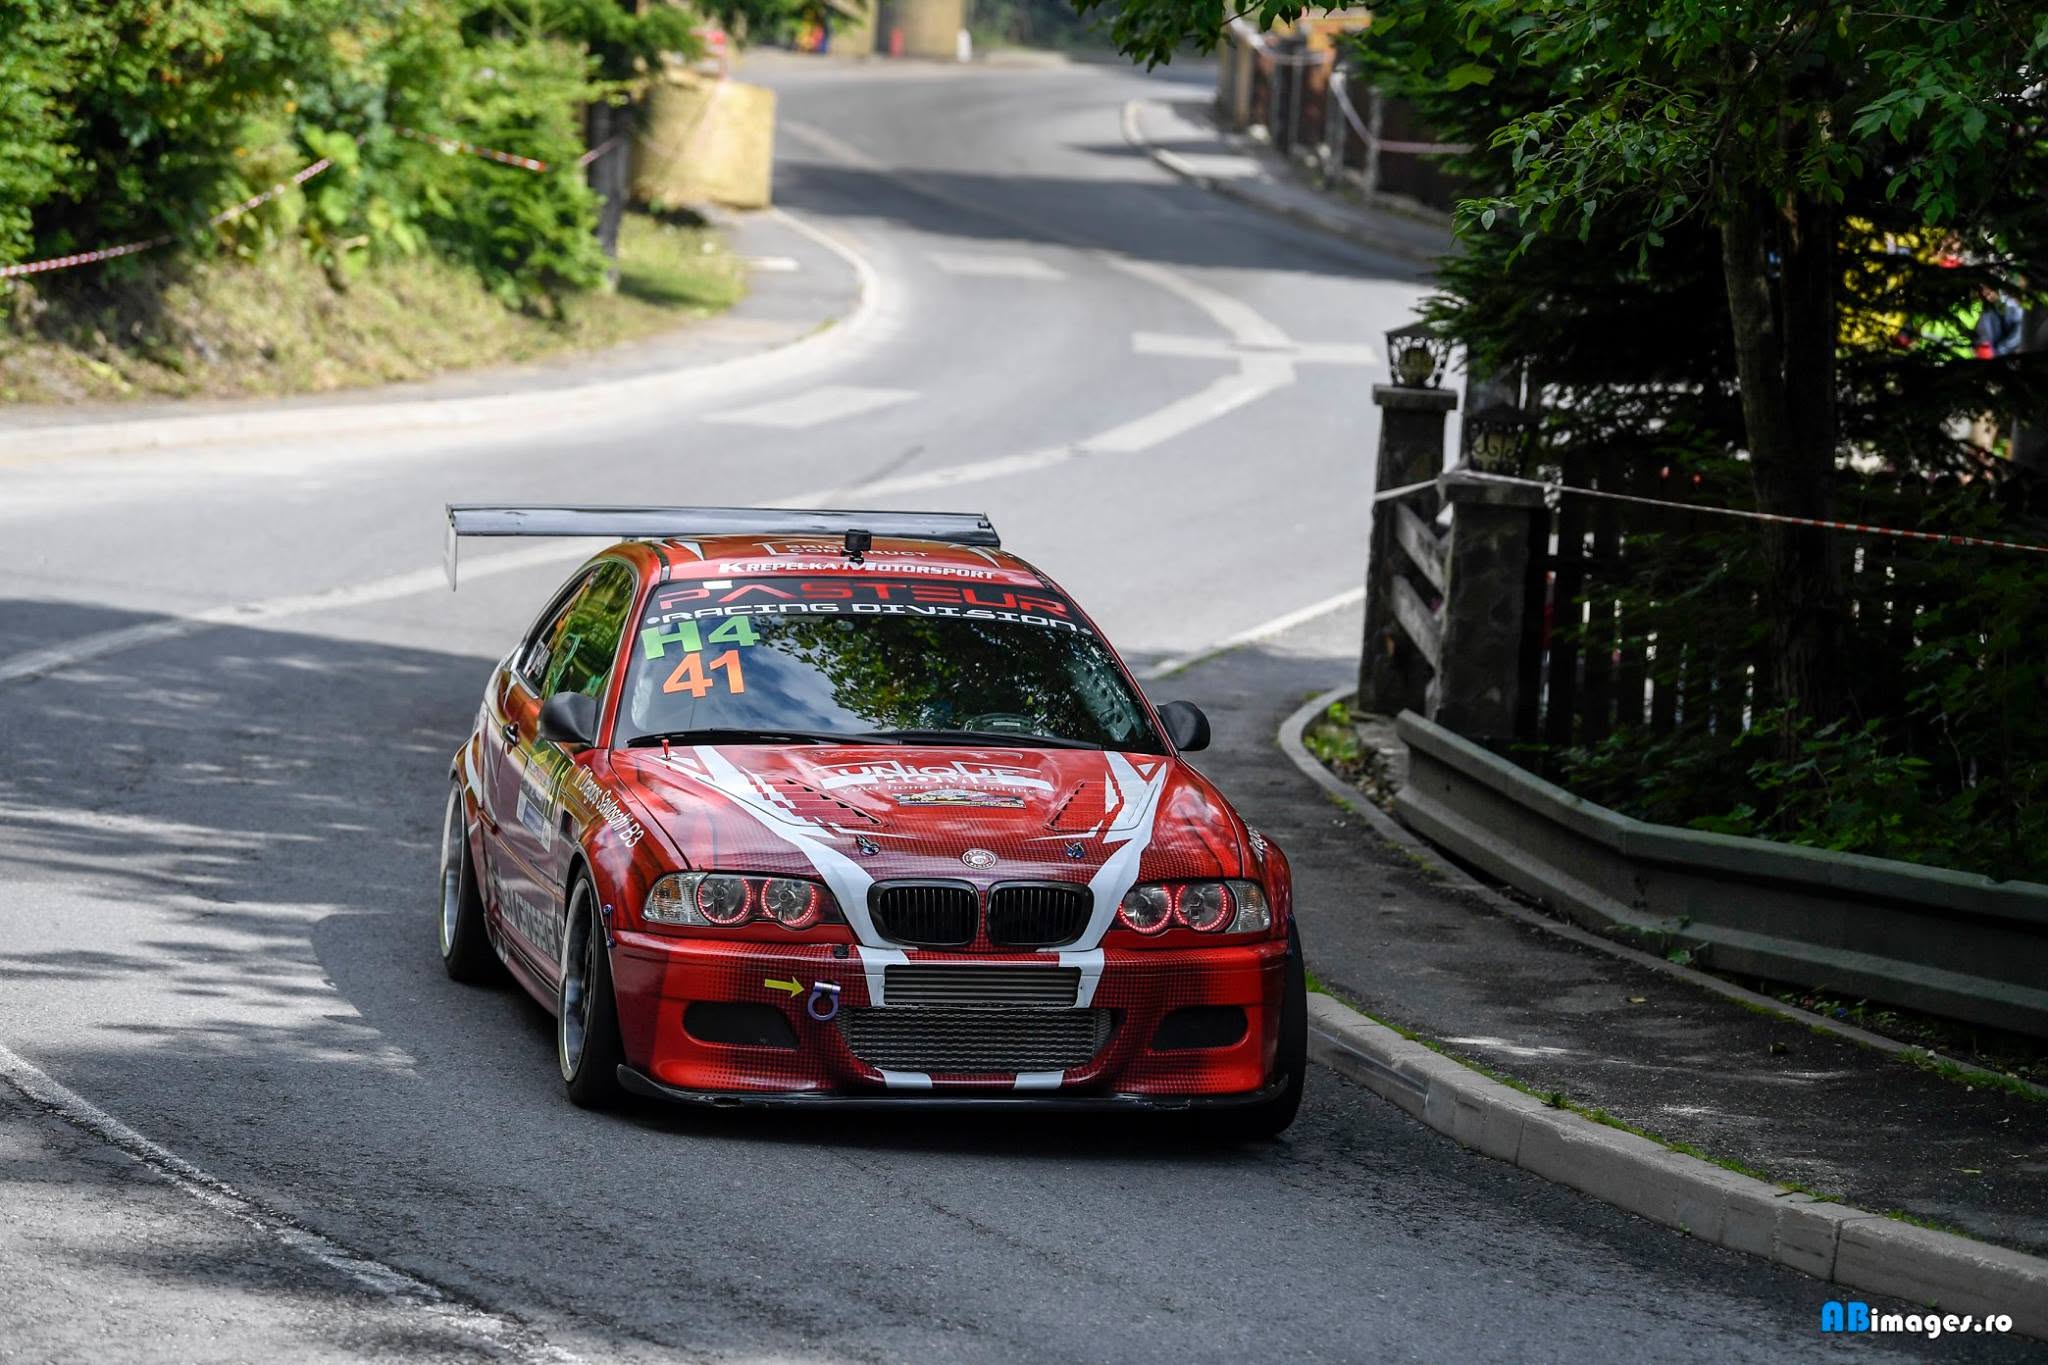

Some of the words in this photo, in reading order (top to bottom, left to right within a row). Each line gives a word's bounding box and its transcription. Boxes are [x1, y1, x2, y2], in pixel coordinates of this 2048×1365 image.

[718, 561, 838, 575] KREPELKA
[843, 561, 995, 579] MOTORSPORT
[658, 582, 1073, 620] PASTEUR
[661, 603, 839, 624] RACING
[851, 603, 1078, 632] DIVISION
[641, 615, 761, 660] H4
[663, 649, 745, 698] 41
[619, 822, 645, 848] B3
